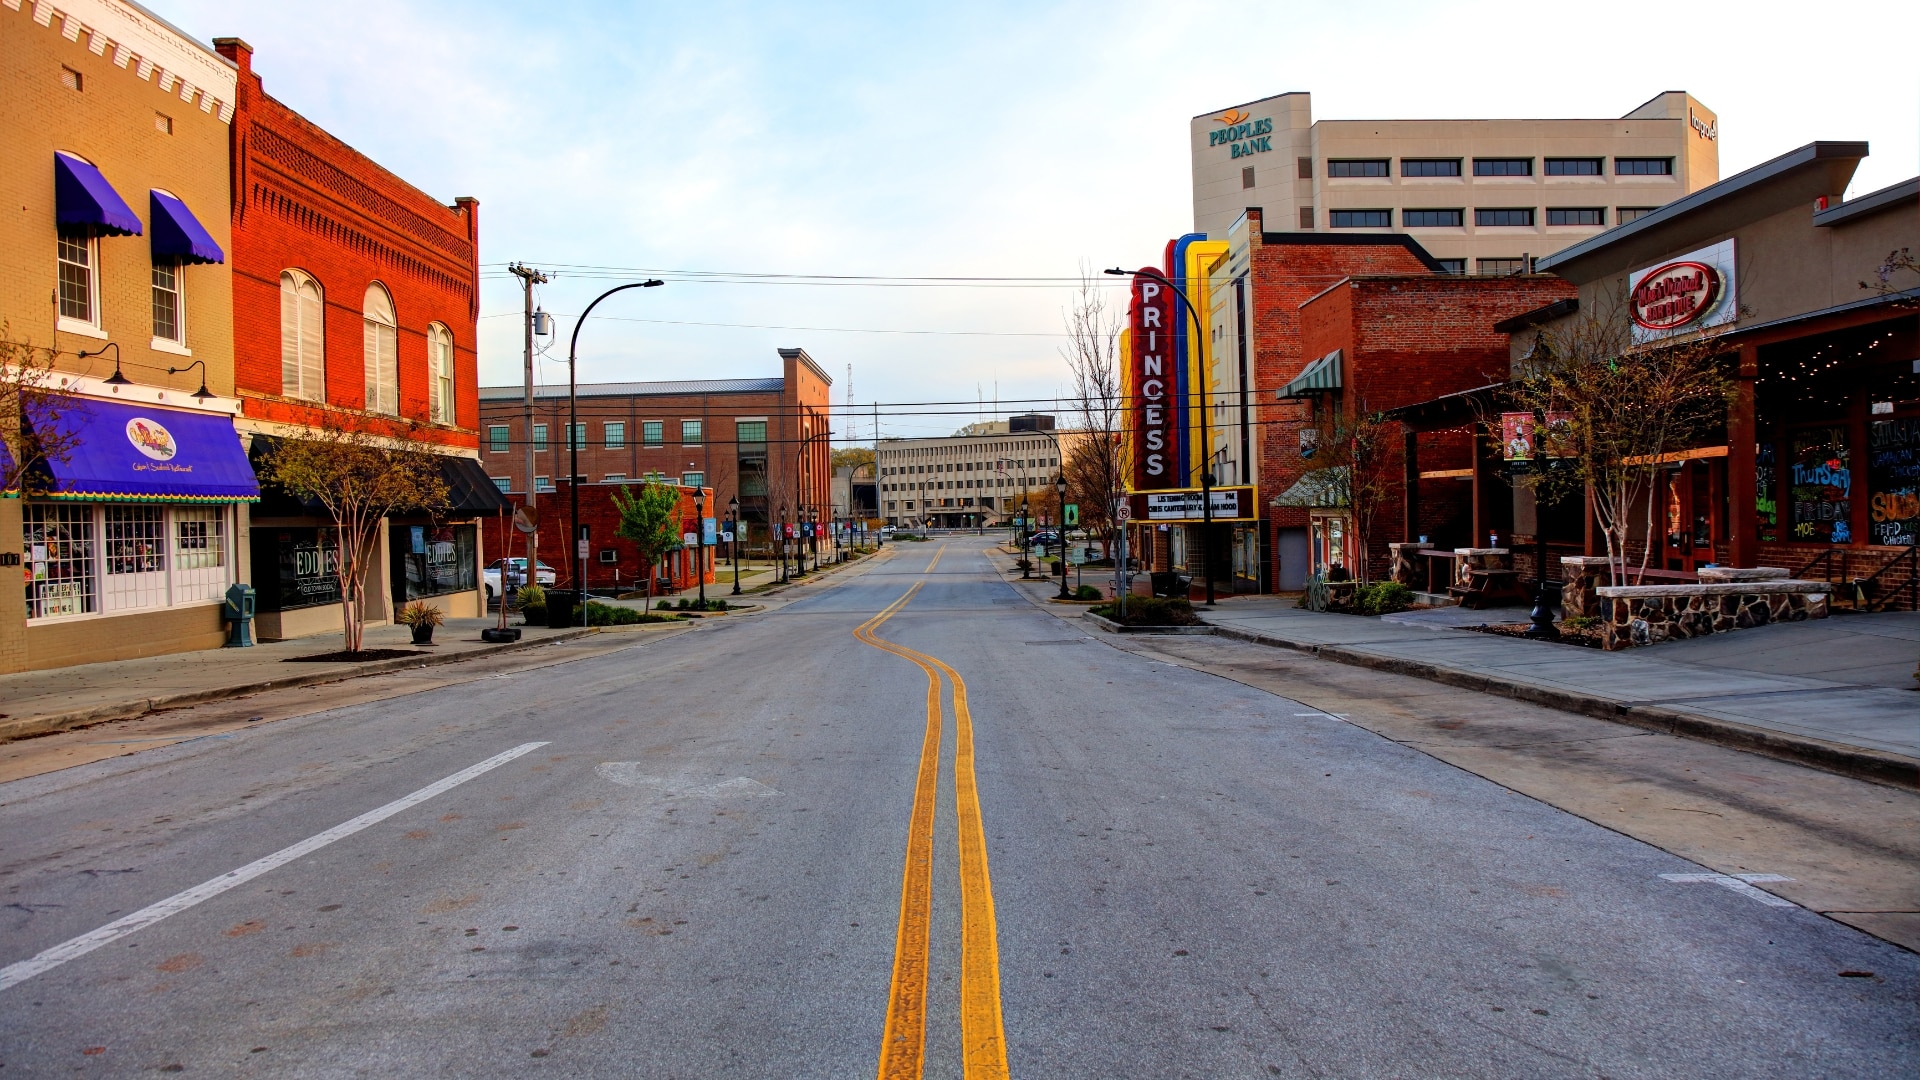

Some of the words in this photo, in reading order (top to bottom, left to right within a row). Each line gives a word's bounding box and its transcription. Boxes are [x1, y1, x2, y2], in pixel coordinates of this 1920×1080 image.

[1209, 117, 1273, 147] PEOPLES
[1231, 136, 1272, 159] BANK
[1638, 281, 1663, 308] Moe's
[1663, 271, 1703, 297] Original
[1646, 303, 1667, 321] BAR
[1674, 296, 1695, 315] QUE
[1142, 282, 1164, 476] PRINCESS
[296, 549, 339, 575] EDDIES
[427, 543, 456, 564] EDDIES
